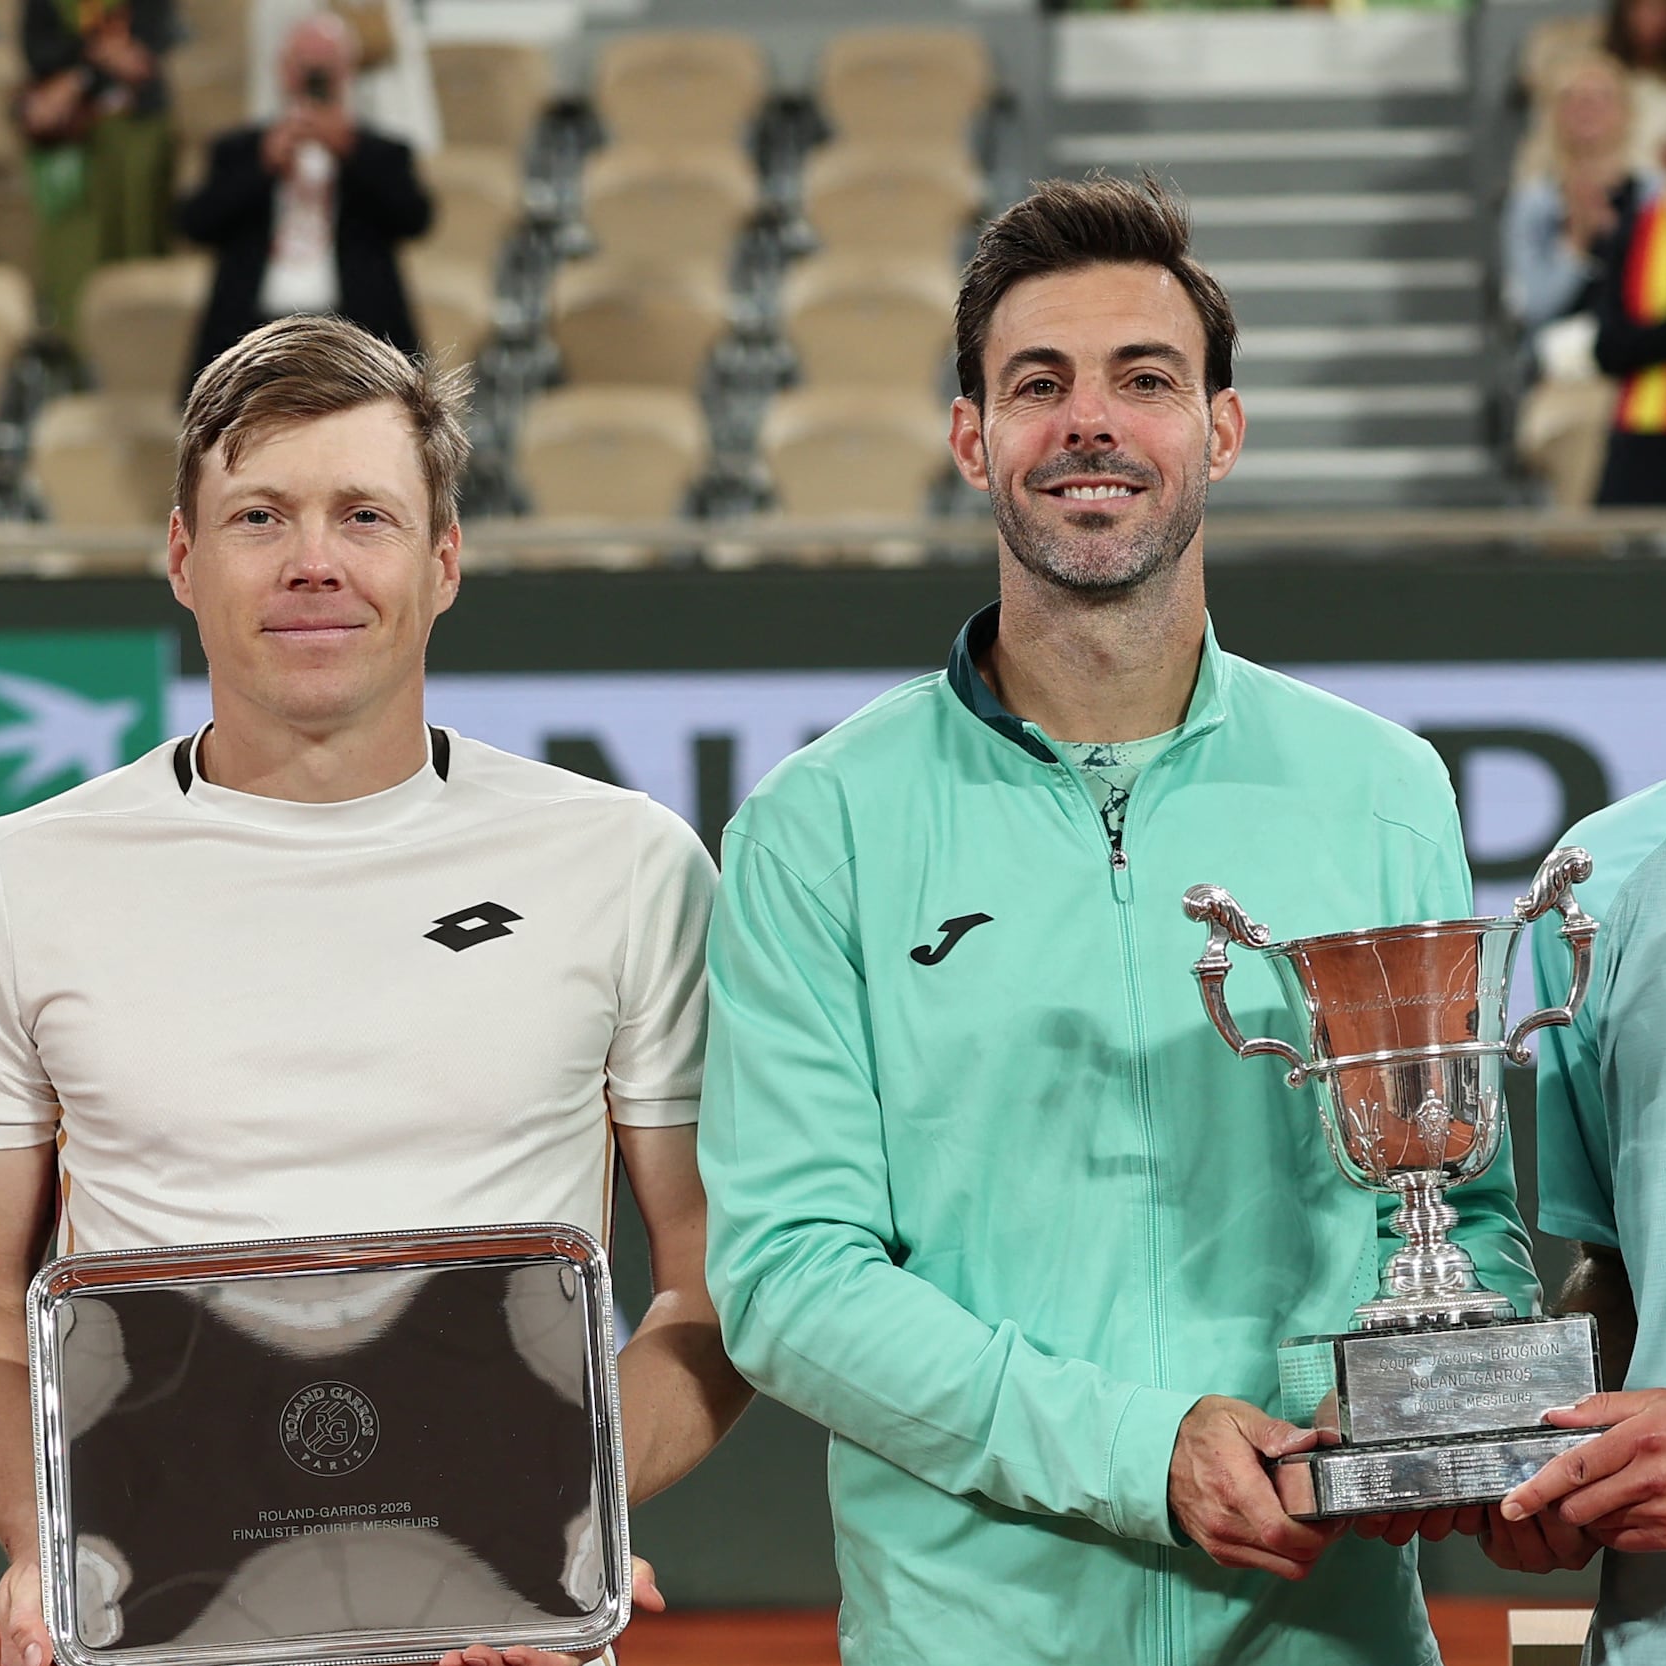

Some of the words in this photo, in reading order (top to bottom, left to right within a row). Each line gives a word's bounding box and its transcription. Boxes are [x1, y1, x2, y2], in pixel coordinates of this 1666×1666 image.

[1379, 1358, 1422, 1371] COUPE
[1490, 1342, 1560, 1361] BRUGNON
[1409, 1373, 1467, 1392] ROLAND
[1473, 1366, 1533, 1384] GARROS
[286, 1387, 327, 1442] ROLAND
[329, 1386, 374, 1437] GARROS
[1413, 1398, 1460, 1413] DOUBLE
[1466, 1391, 1533, 1409] MESSIEURS
[301, 1450, 362, 1471] PARIS
[258, 1503, 377, 1522] ROLAND-GARROS
[380, 1500, 412, 1515] 2026
[232, 1525, 300, 1541] FINALISTE
[303, 1521, 360, 1536] DOUBLE
[362, 1515, 440, 1532] MESSIEURS
